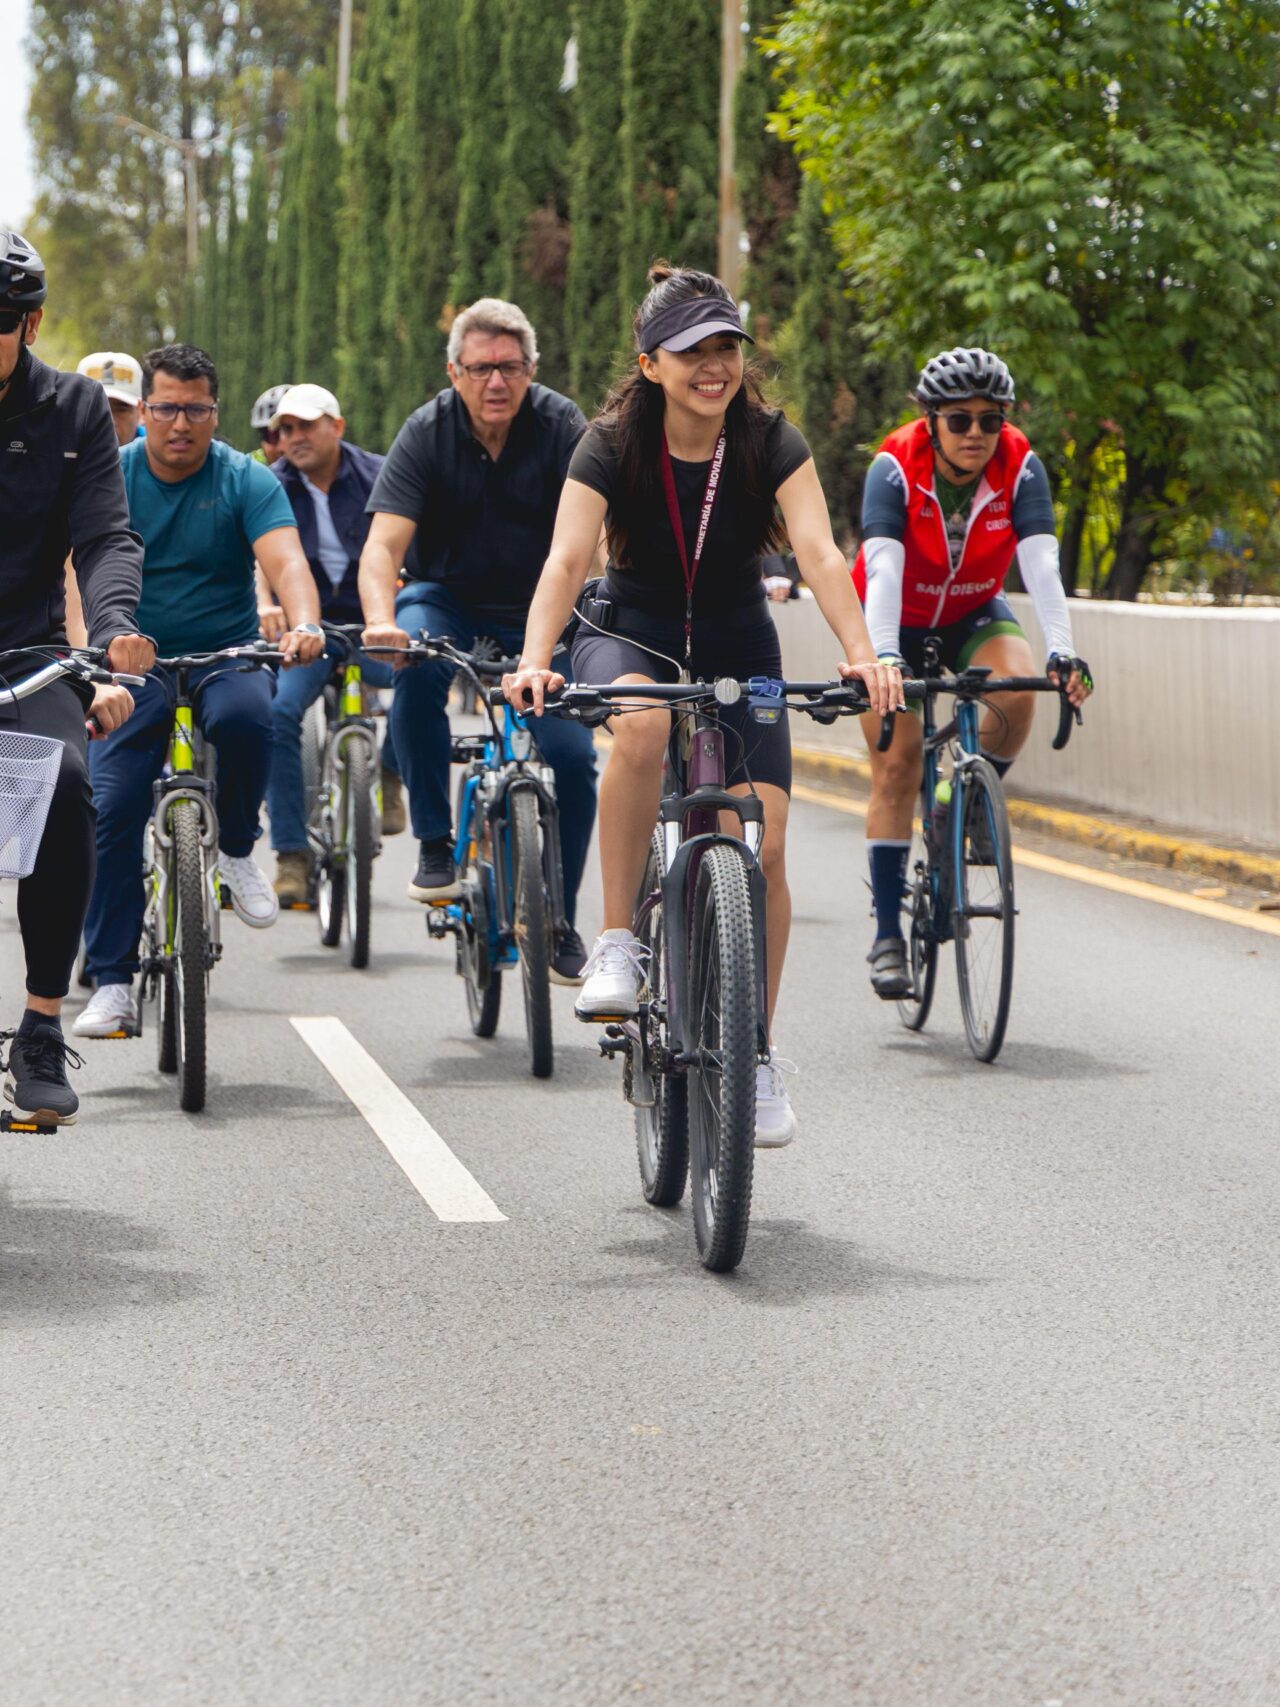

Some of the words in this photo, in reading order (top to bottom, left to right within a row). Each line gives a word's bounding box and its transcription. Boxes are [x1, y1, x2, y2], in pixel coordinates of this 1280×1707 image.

[708, 437, 726, 488] MOVILIDAD
[706, 489, 716, 502] DE
[695, 503, 712, 560] SECRETARÍA
[915, 582, 943, 596] SAN
[950, 578, 996, 596] DIEGO
